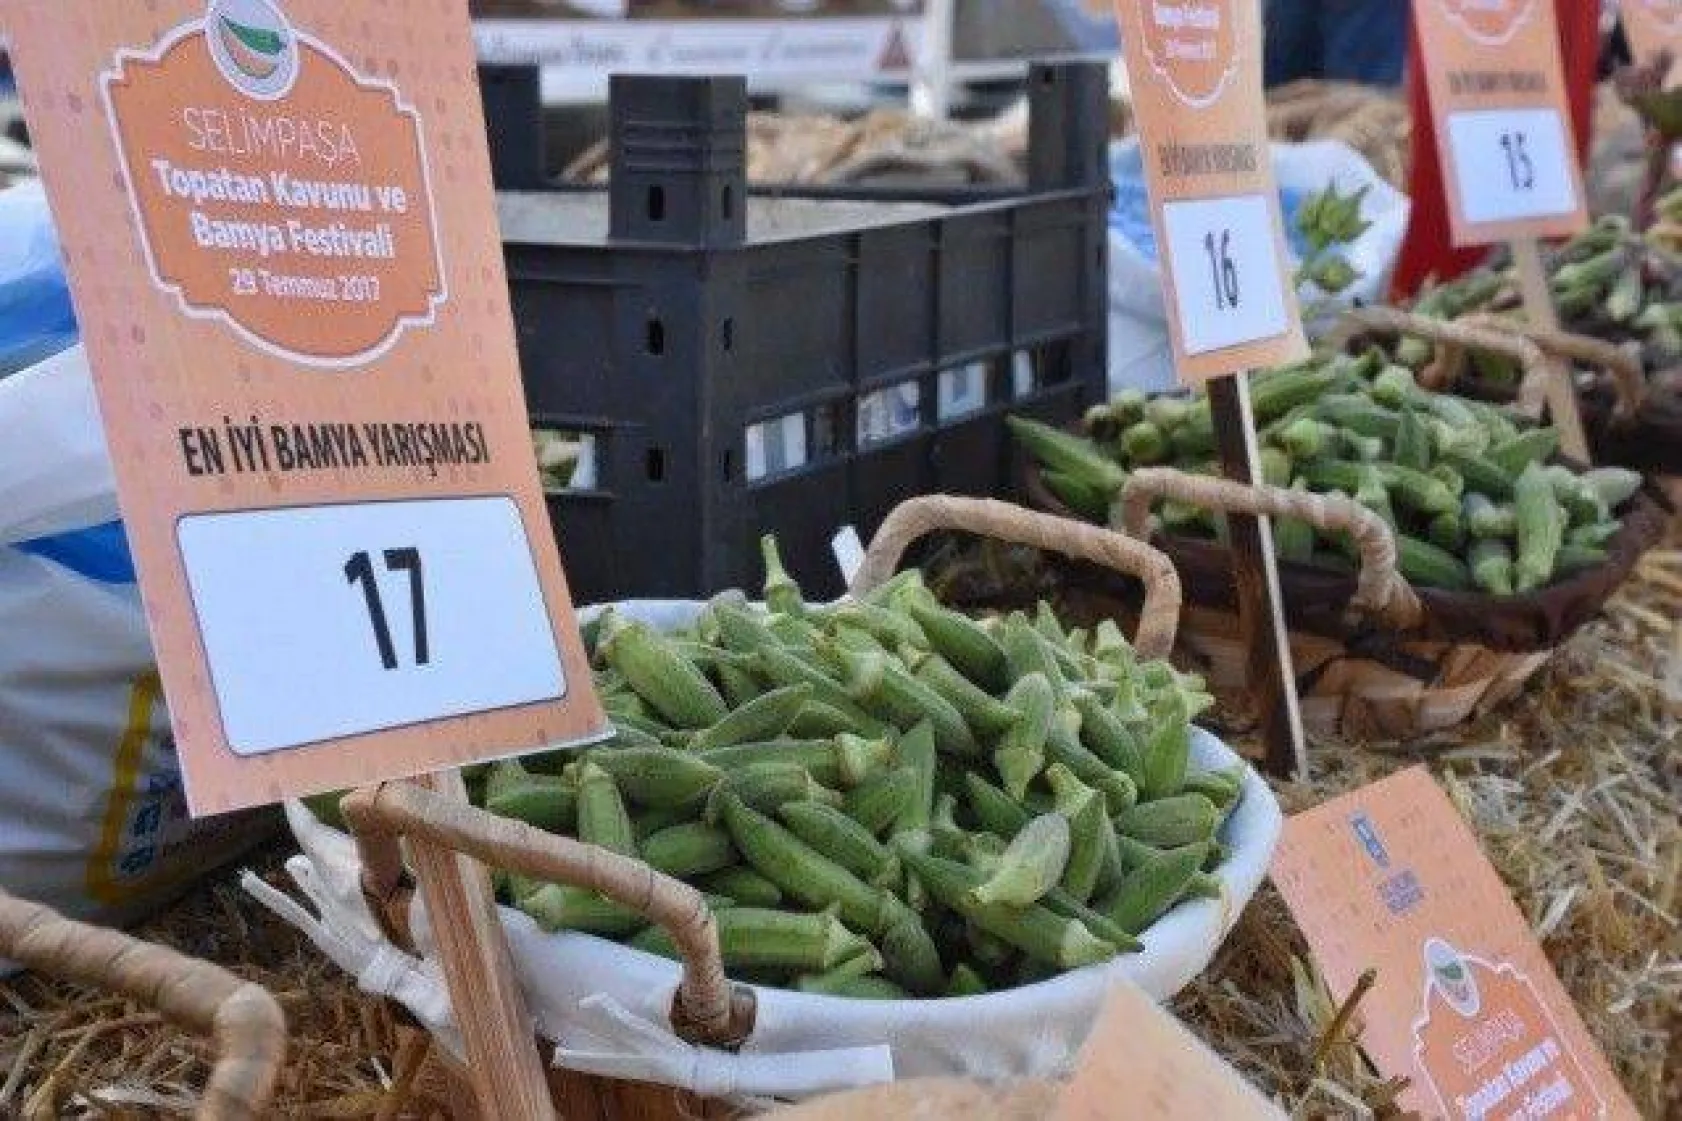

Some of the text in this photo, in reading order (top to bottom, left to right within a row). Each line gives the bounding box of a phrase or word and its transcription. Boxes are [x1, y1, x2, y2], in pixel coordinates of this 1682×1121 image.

[152, 158, 406, 213] Topatan Kavunu ve
[1499, 131, 1533, 191] 15
[190, 209, 394, 259] Bamya Festivali
[1204, 229, 1238, 310] 16
[178, 414, 491, 477] EN İYİ BAMYA YARIŞMASI
[343, 546, 430, 670] 17
